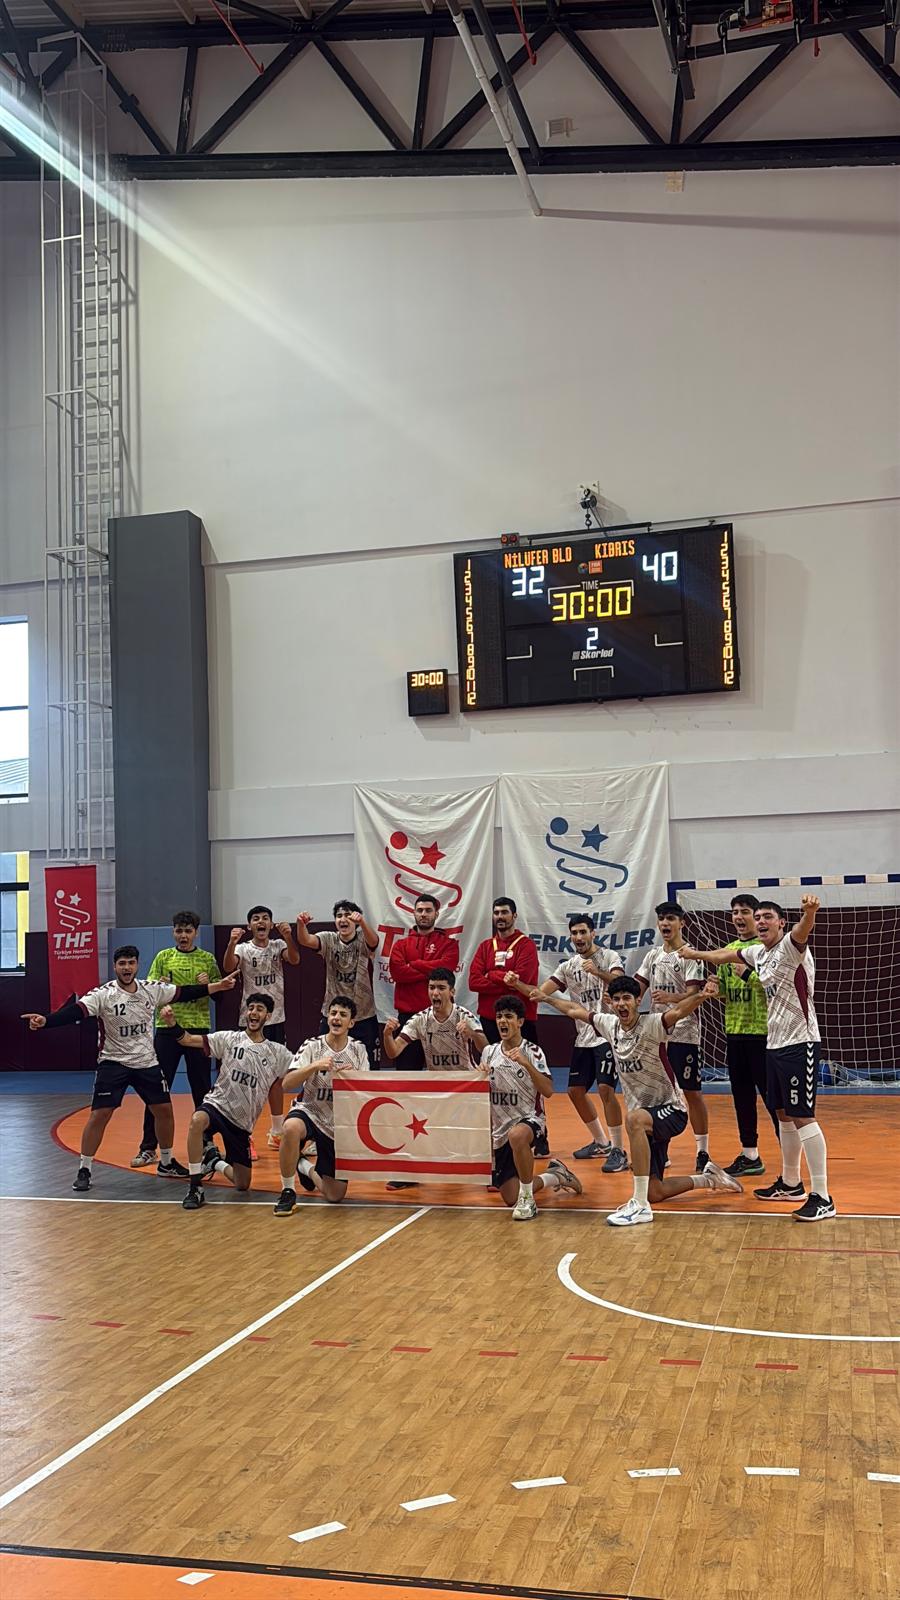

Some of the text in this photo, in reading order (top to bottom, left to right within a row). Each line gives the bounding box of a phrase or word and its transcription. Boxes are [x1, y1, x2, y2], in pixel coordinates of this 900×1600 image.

[724, 531, 728, 543] 1
[594, 540, 635, 559] KIBRIS
[720, 543, 728, 556] 2
[467, 559, 471, 571] 1
[642, 551, 678, 581] 40
[721, 556, 729, 569] 3
[464, 571, 471, 583] 2
[511, 565, 545, 596] 32
[721, 569, 730, 581] 4
[465, 583, 472, 595] 3
[581, 580, 599, 590] TIME
[722, 581, 730, 593] 5
[465, 595, 472, 607] 4
[552, 586, 632, 621] 30:00
[723, 593, 730, 607] 6
[466, 607, 473, 619] 5
[723, 607, 731, 619] 7
[466, 619, 473, 632] 6
[724, 620, 731, 633] 8
[467, 632, 474, 643] 7
[586, 627, 599, 650] 2
[725, 633, 732, 646] 9
[467, 644, 474, 655] 8
[580, 648, 614, 660] Skorled
[723, 646, 732, 659] 10
[468, 655, 475, 668] 9
[724, 659, 733, 671] 11
[411, 672, 443, 687] 30:00
[466, 668, 475, 680] 10
[724, 671, 734, 684] 12
[467, 681, 476, 692] 11
[467, 692, 476, 705] 12
[53, 931, 93, 949] THF
[528, 928, 656, 953] ERKKLER
[252, 957, 258, 967] 6
[254, 971, 276, 986] UKÜ
[573, 970, 582, 982] 11
[114, 1004, 126, 1016] 12
[119, 1020, 147, 1037] UKÜ
[427, 1032, 433, 1043] 7
[233, 1046, 245, 1060] 10
[432, 1051, 460, 1066] UKÜ
[600, 1060, 612, 1075] 11
[683, 1066, 692, 1080] 8
[231, 1069, 257, 1088] UKÜ
[491, 1090, 519, 1106] UKÜ
[791, 1089, 798, 1105] 5
